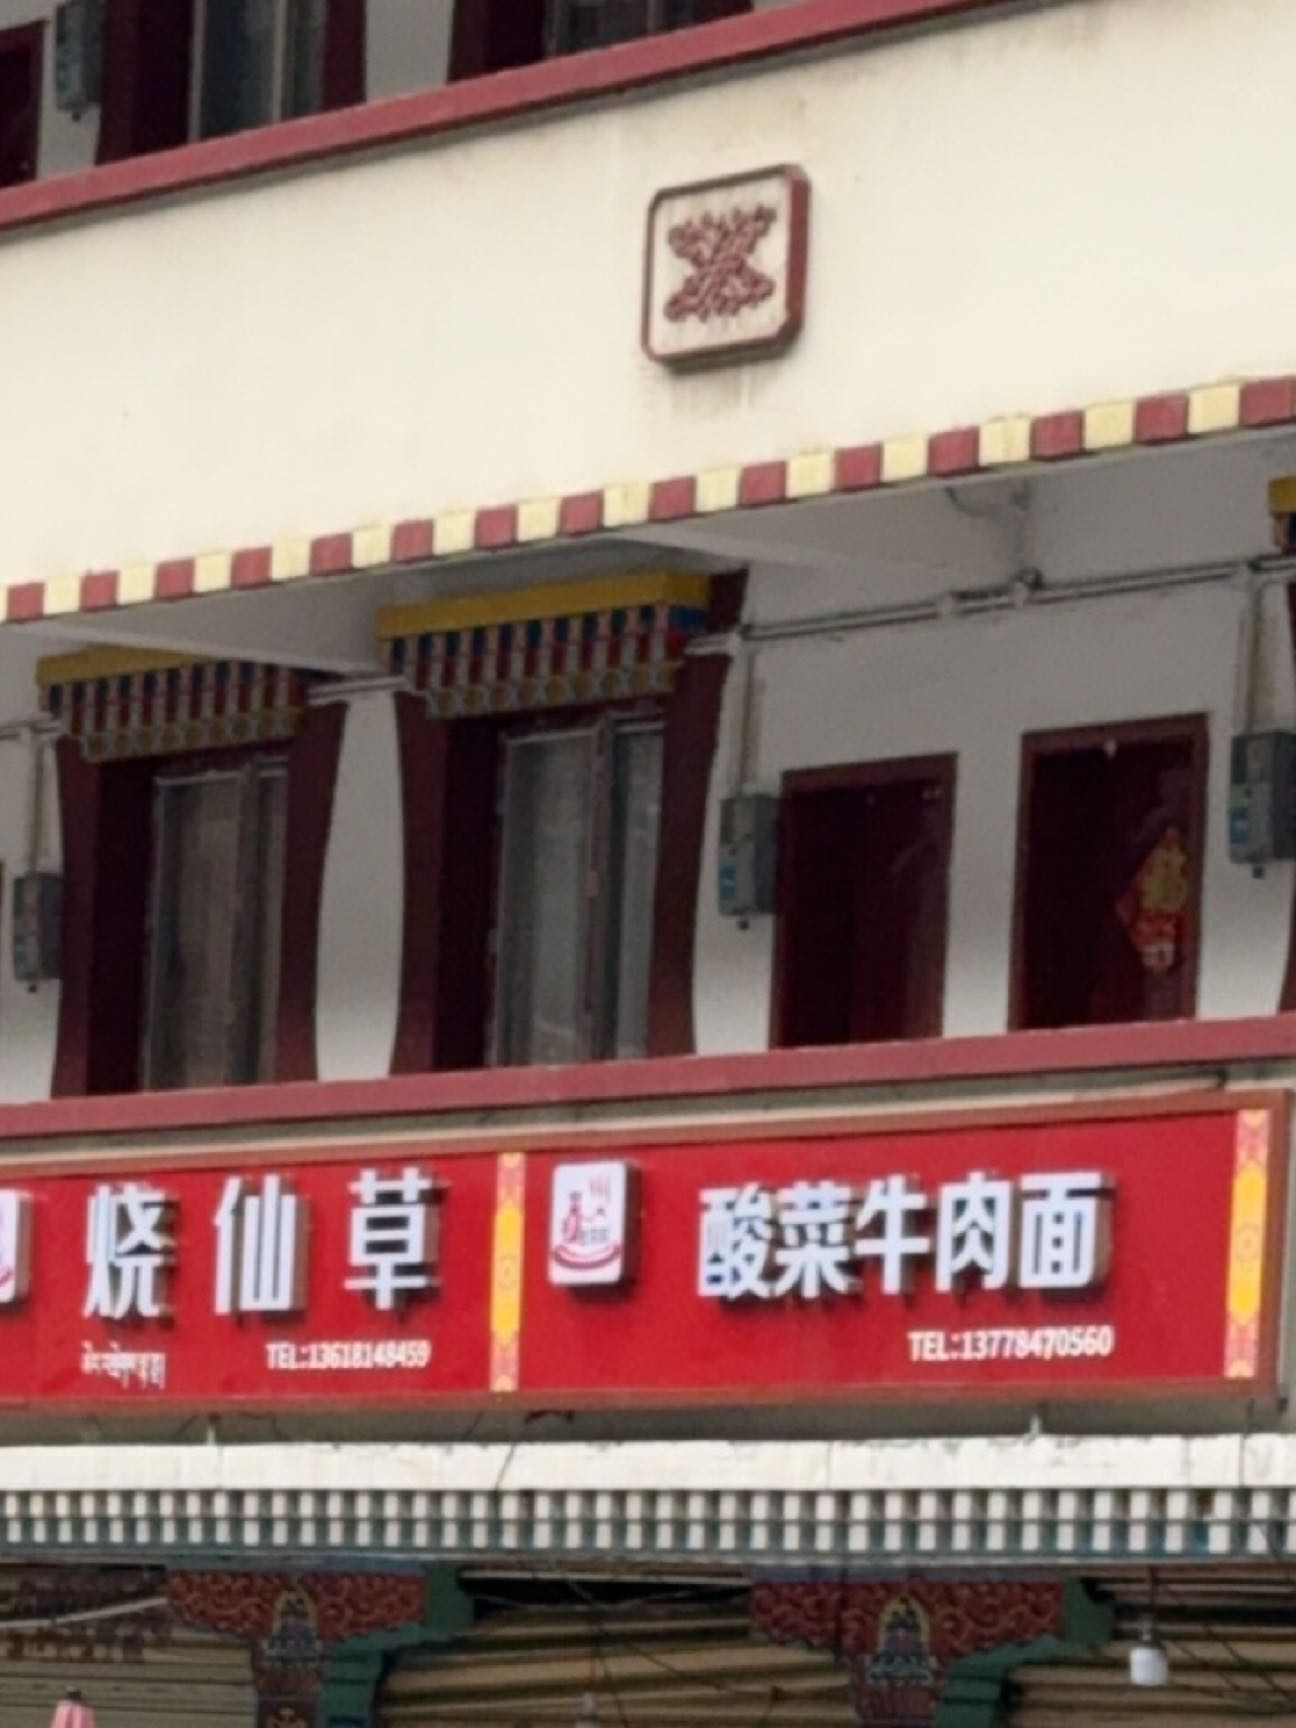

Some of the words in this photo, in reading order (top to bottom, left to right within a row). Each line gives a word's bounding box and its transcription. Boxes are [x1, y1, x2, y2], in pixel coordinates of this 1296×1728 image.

[82, 1167, 441, 1320] 烧仙草
[697, 1171, 1106, 1300] 酸菜牛肉面
